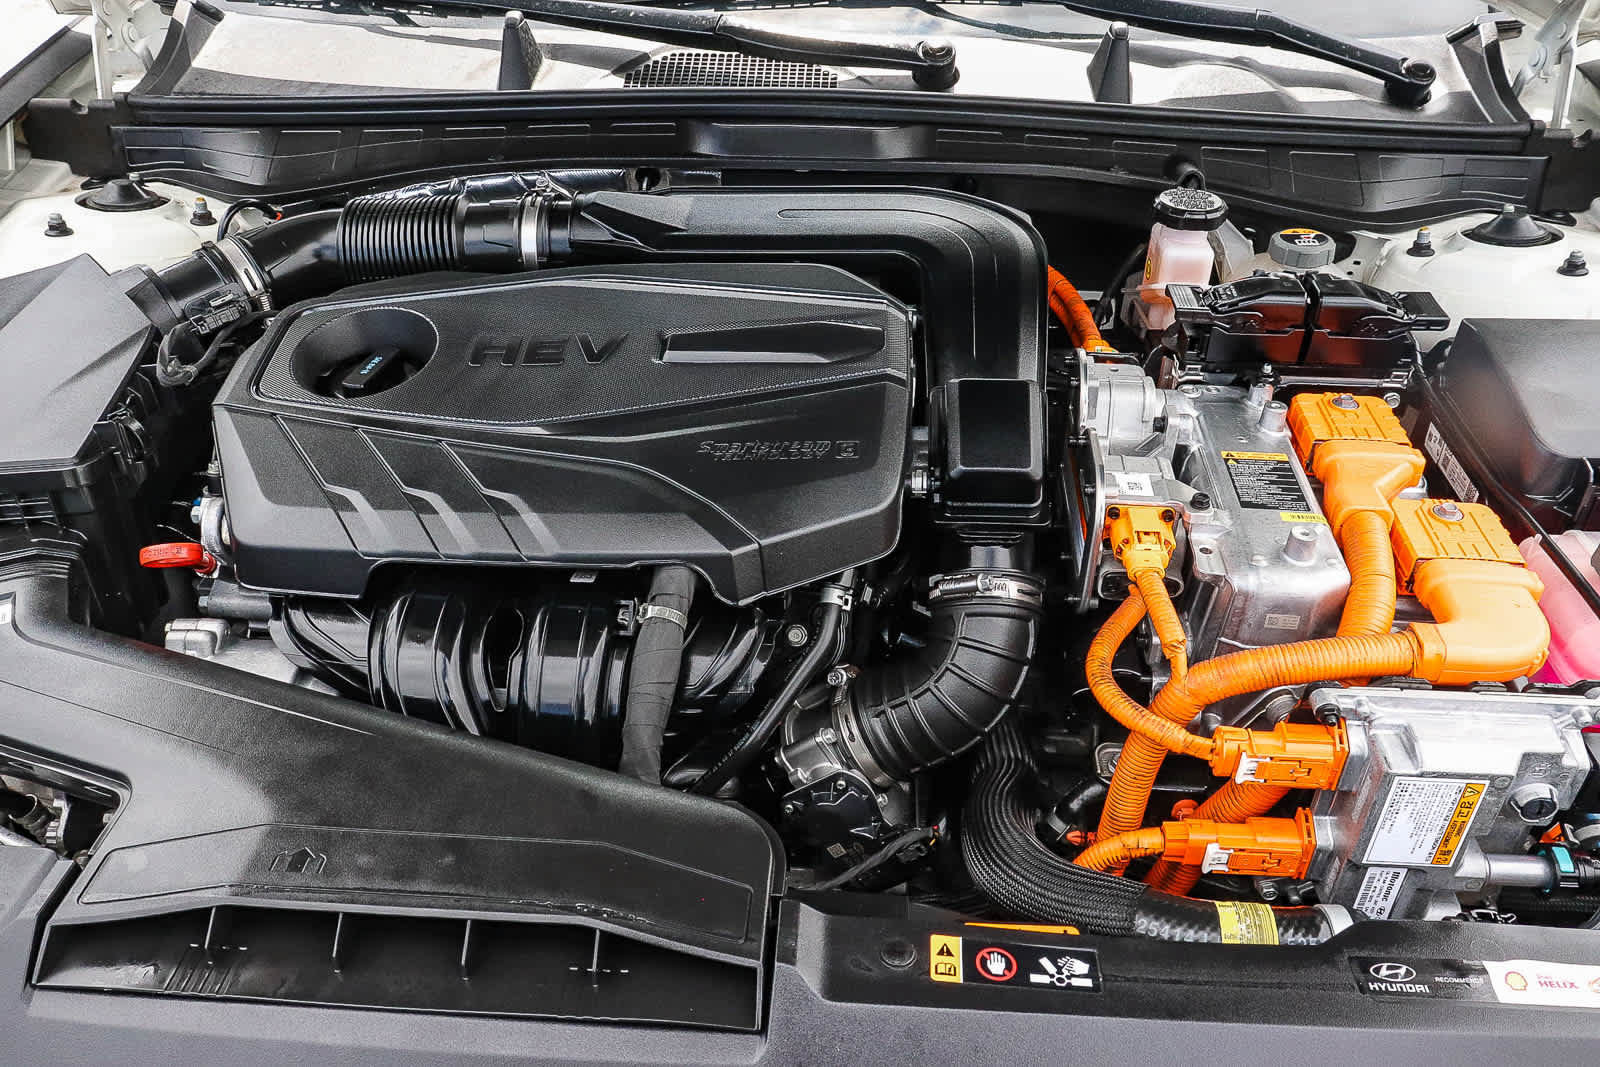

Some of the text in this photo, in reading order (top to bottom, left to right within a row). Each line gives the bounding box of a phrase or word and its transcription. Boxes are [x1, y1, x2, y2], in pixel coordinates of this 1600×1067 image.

[467, 332, 630, 367] HEV
[1457, 801, 1475, 818] 경고
[1368, 982, 1430, 993] HYUNDAI
[1538, 980, 1580, 990] HELIX
